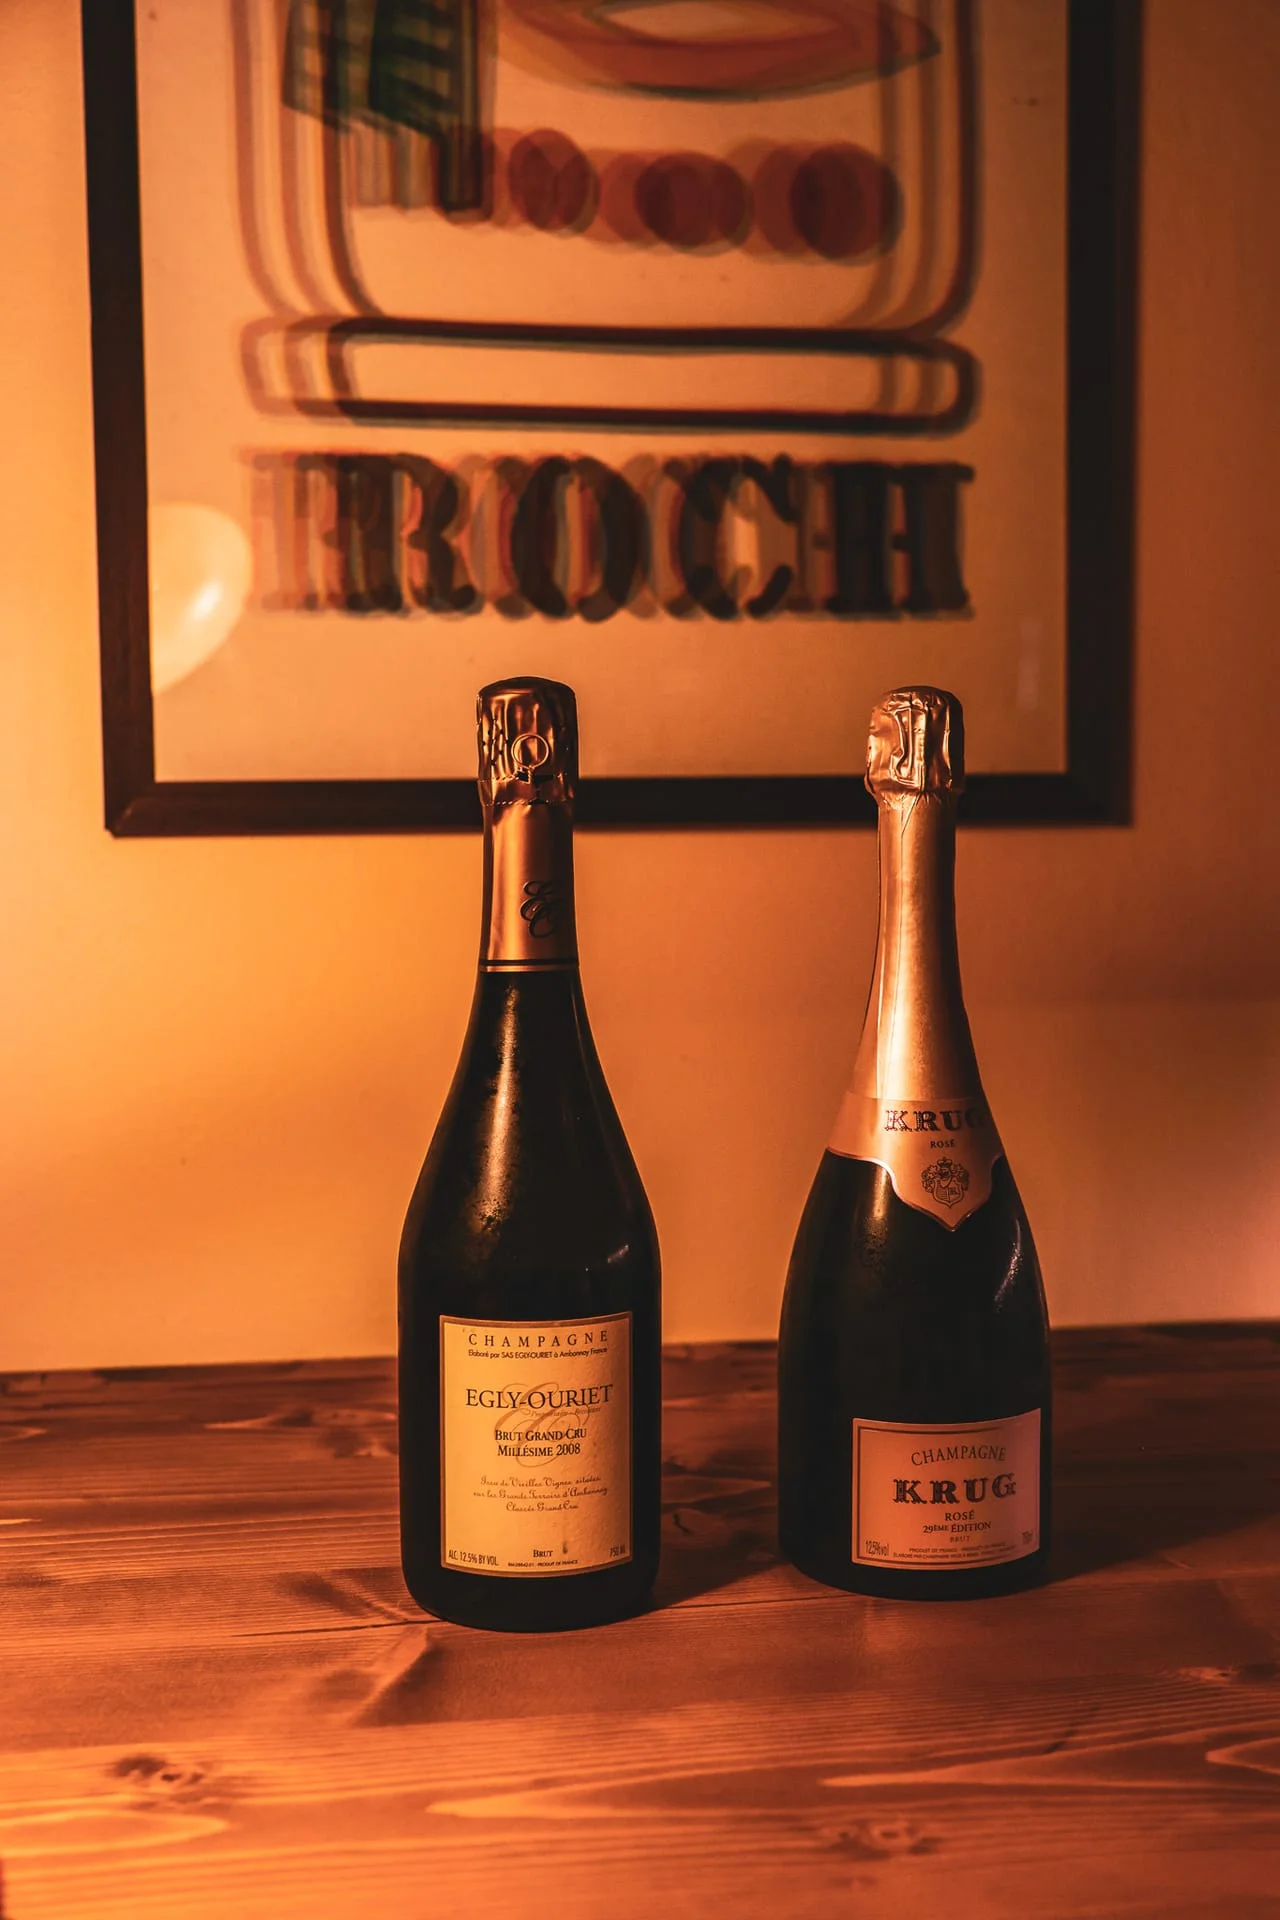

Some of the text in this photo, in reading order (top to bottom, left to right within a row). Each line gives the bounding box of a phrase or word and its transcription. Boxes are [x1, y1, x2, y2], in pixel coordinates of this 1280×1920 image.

[468, 1330, 608, 1348] CHAMPAGNE
[501, 1351, 514, 1359] SAS
[465, 1384, 614, 1410] EGLY-OURIET
[495, 1429, 523, 1441] BRUT
[525, 1429, 563, 1441] GRAND
[556, 1443, 581, 1456] 2008
[911, 1444, 1007, 1466] CHAMPAGNE
[893, 1472, 1017, 1505] KRUG
[944, 1509, 975, 1522] ROSÉ
[951, 1521, 991, 1533] ÉDITION
[478, 1552, 486, 1565] BY
[532, 1549, 553, 1558] BRUT
